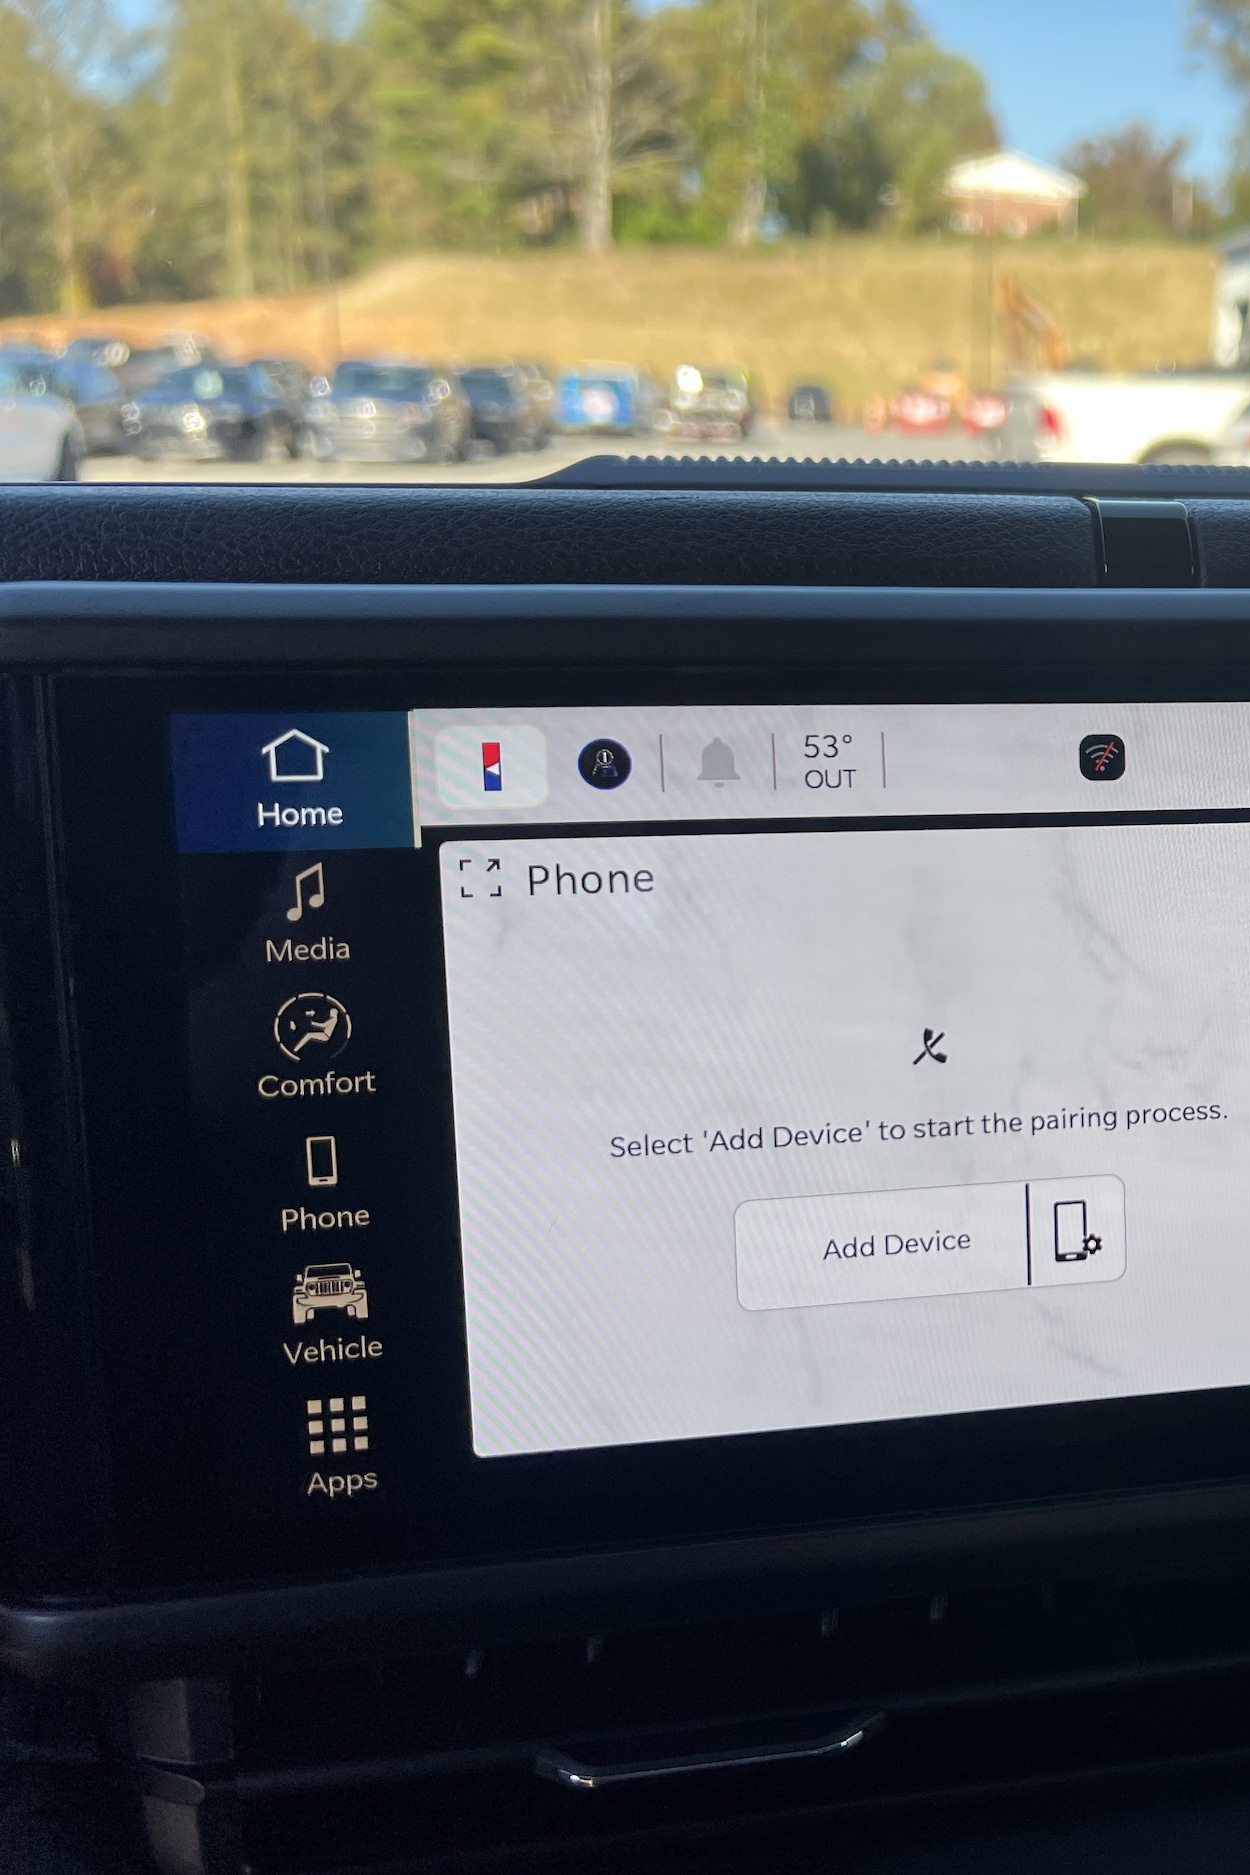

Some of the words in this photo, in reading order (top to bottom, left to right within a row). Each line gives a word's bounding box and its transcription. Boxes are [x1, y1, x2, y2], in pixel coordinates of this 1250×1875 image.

[805, 735, 853, 760] 53°
[804, 768, 857, 790] OUT
[258, 803, 345, 828] Home
[529, 864, 655, 897] Phone
[267, 937, 351, 964] Media
[259, 1071, 378, 1098] Comfort
[611, 1135, 691, 1159] Select
[702, 1123, 765, 1153] 'Add
[774, 1121, 871, 1149] Device'
[879, 1122, 907, 1142] to
[914, 1117, 974, 1140] start
[983, 1113, 1023, 1135] the
[1032, 1108, 1118, 1136] pairing
[1127, 1105, 1229, 1126] process.
[282, 1207, 371, 1233] Phone
[824, 1237, 876, 1261] Add
[886, 1231, 972, 1257] Device
[284, 1336, 384, 1365] Vehicle
[308, 1473, 379, 1499] Apps
